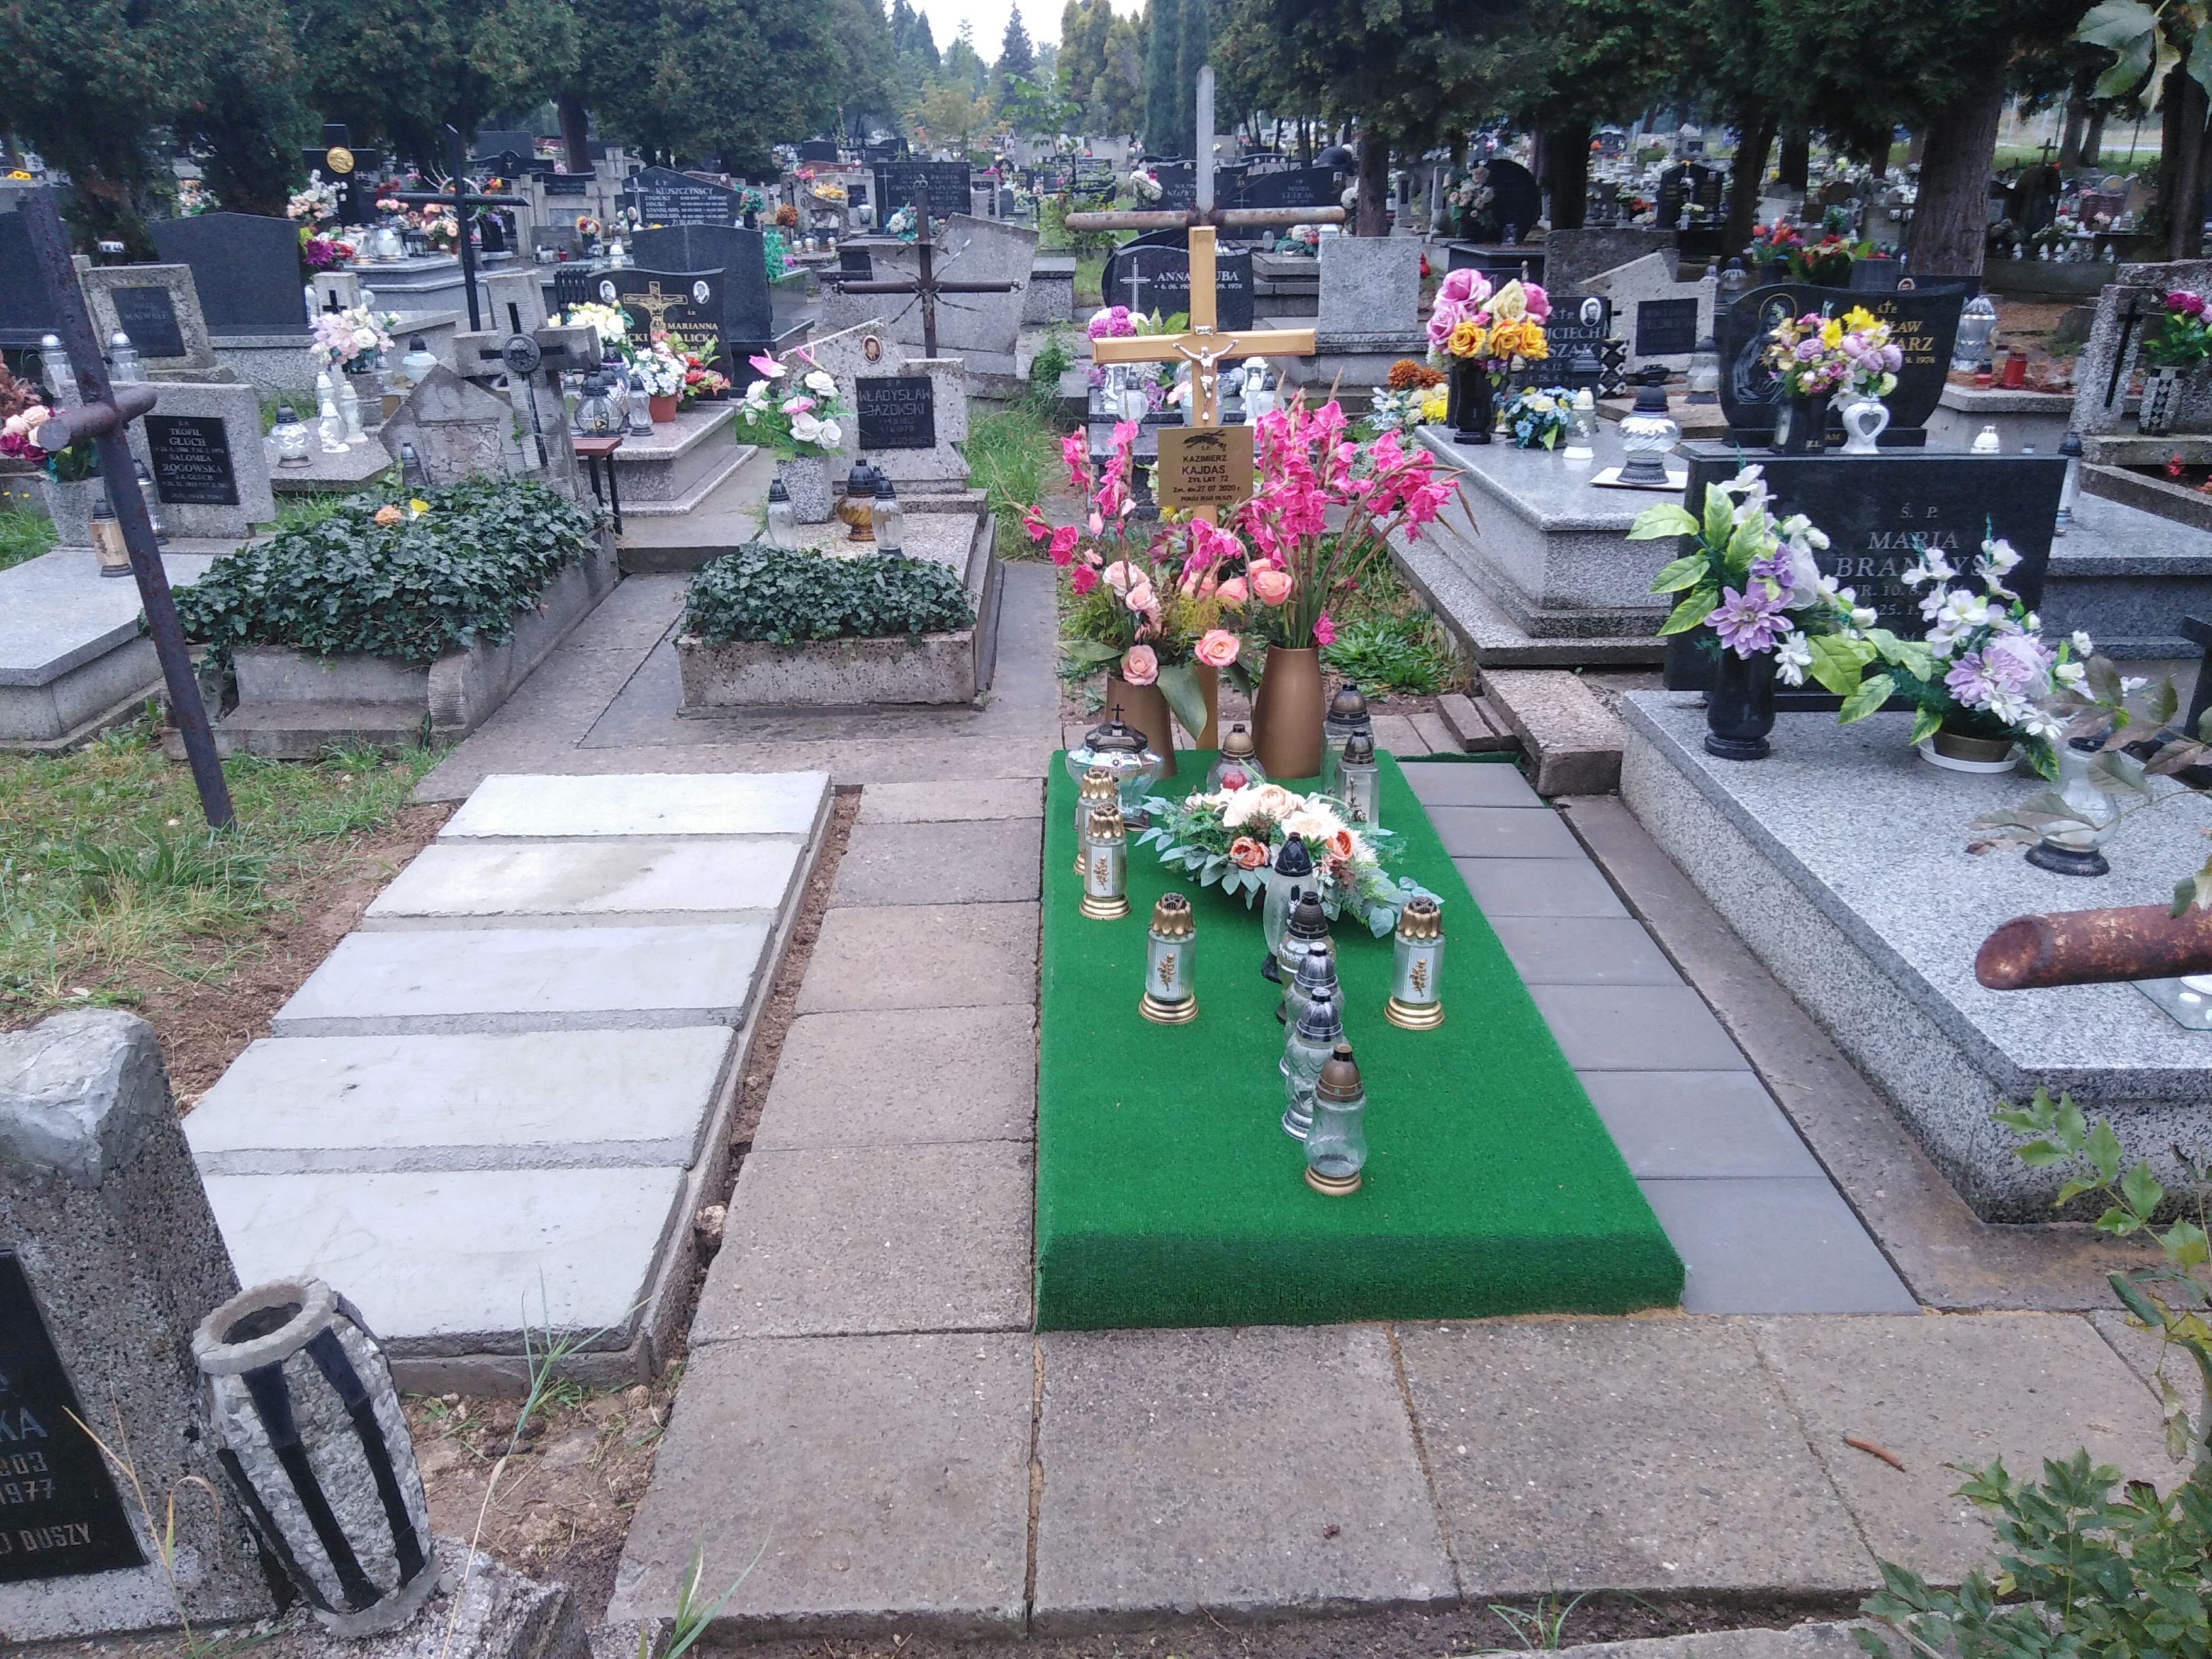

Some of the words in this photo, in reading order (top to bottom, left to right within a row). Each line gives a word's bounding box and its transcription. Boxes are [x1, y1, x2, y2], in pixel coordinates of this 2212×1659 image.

[1157, 271, 1191, 281] ANNA
[1890, 321, 1923, 333] ŁAW
[859, 389, 930, 402] WŁADYSŁAW
[169, 428, 201, 436] TEOFIL
[1183, 455, 1227, 463] KAZIMIERZ
[163, 464, 223, 473] ROGOWSKA
[1181, 465, 1226, 475] KAJDAS
[1866, 531, 1959, 550] MARIA
[1835, 557, 1986, 577] BRANYS
[19, 1523, 91, 1552] DUSZY
